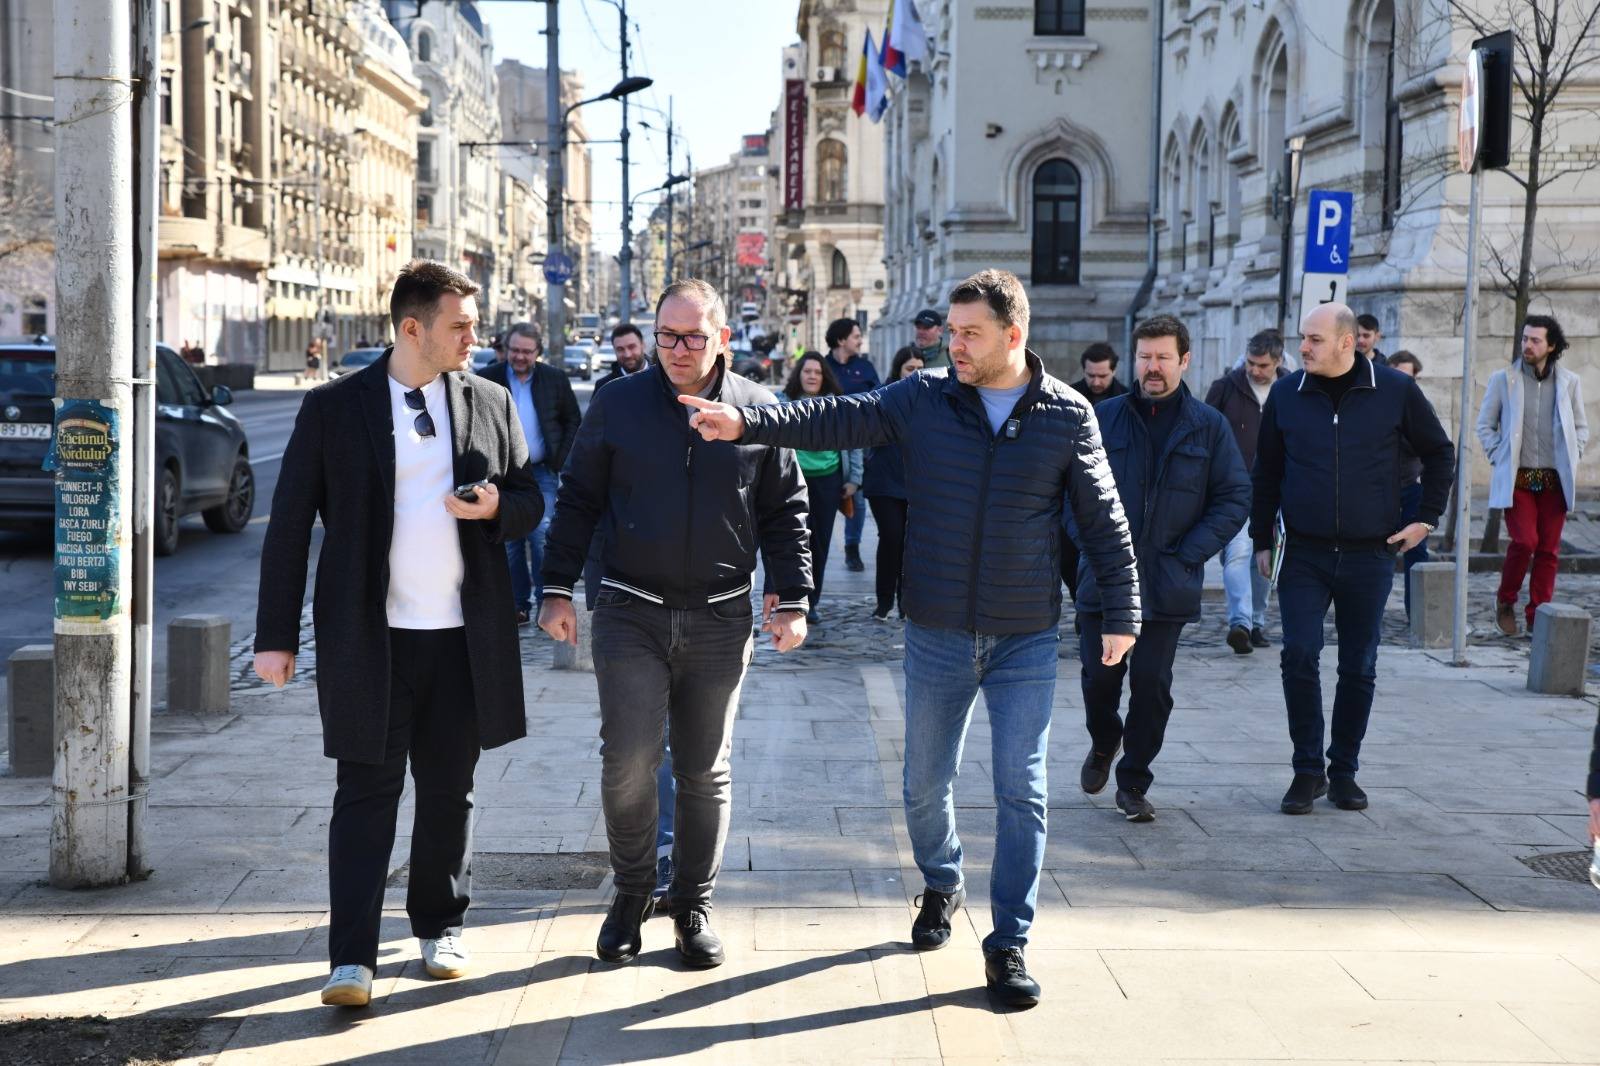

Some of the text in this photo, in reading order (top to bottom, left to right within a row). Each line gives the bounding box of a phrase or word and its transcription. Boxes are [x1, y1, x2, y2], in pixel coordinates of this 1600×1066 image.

[788, 100, 800, 210] ELISABETA
[1316, 200, 1342, 246] P
[20, 424, 48, 437] DYZ
[56, 444, 112, 460] Nordului
[60, 481, 103, 492] CONNECT-R
[61, 493, 101, 504] HOLOGRAF
[69, 506, 90, 517] LORA
[81, 519, 105, 530] ZURLI
[67, 531, 92, 542] FUEGO
[56, 543, 83, 554] NARCISA
[77, 556, 105, 567] BERTZI
[71, 568, 87, 579] BIBI
[63, 580, 97, 592] YNY SEBI
